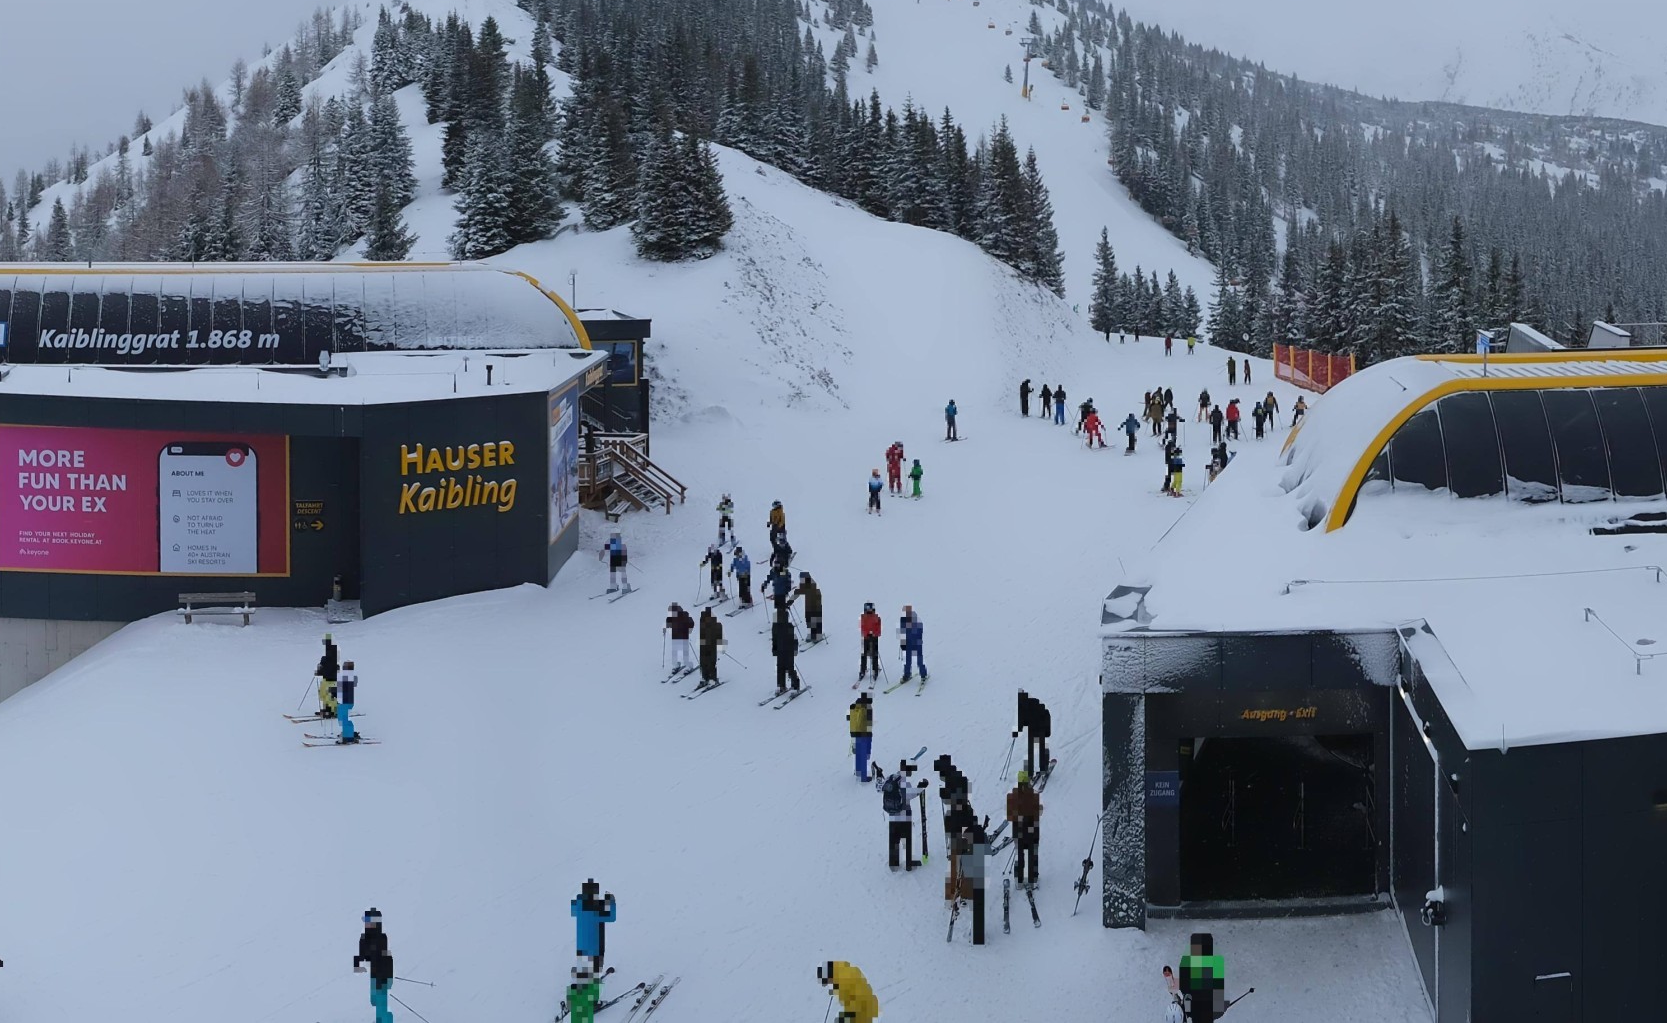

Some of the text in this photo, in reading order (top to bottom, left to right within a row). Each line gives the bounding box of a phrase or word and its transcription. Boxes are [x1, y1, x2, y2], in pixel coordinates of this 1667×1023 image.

[38, 328, 280, 355] Kaiblinggrat 1.868 m
[18, 449, 85, 468] MORE
[400, 440, 515, 476] HAUSER
[18, 472, 127, 491] FUN THAN
[20, 495, 107, 512] YOUR EX
[398, 475, 517, 514] Kaibling
[1241, 709, 1287, 721] Ausgang
